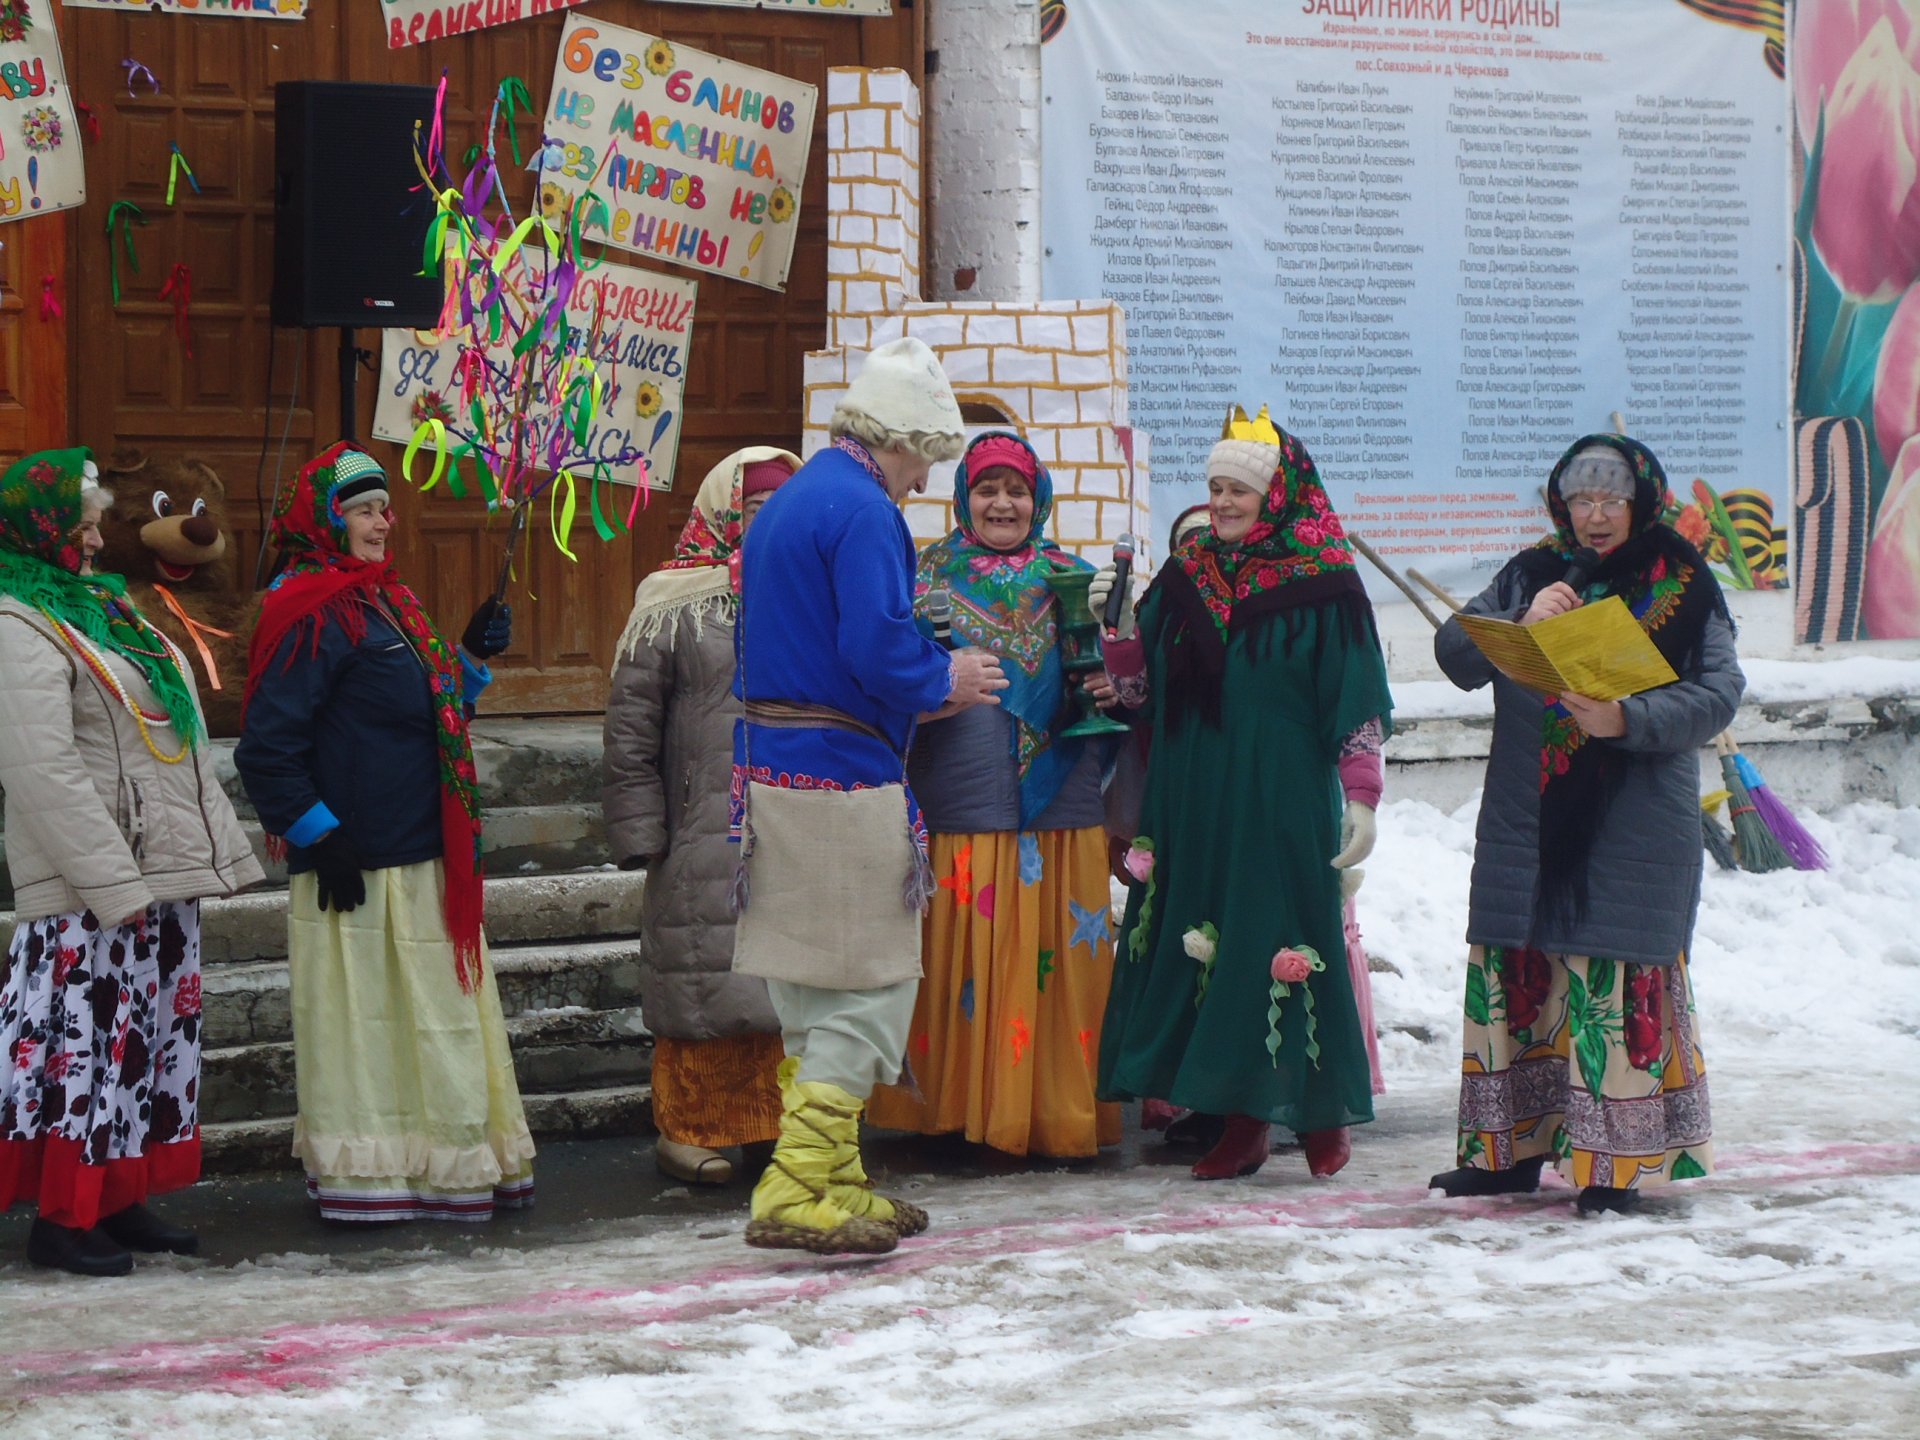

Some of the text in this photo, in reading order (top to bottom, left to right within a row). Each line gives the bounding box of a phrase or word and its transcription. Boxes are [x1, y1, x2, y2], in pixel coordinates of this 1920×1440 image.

[1284, 35, 1349, 49] восстановили
[1133, 72, 1223, 88] Анатолий Иванович
[1337, 82, 1360, 95] Иван
[1184, 94, 1213, 106] Ильич
[1317, 98, 1414, 114] Григорий Васильевич
[1141, 108, 1218, 124] Иван Степанович
[1326, 116, 1405, 133] Михаил Петрович
[1137, 126, 1177, 140] Николай
[1357, 135, 1409, 149] Васильевич
[546, 138, 597, 181] ез
[1141, 144, 1224, 162] Алексей Петрович
[1322, 151, 1415, 167] Василий Алексеевич
[1143, 163, 1226, 179] Иван Дмитриевич
[1317, 169, 1356, 182] Василий
[1459, 173, 1486, 186] Попов
[1359, 188, 1412, 202] Артемьевич
[1468, 190, 1495, 204] Попов
[1168, 200, 1218, 215] Андреевич
[1331, 205, 1399, 218] Иван Иванович
[1466, 208, 1493, 221] Попов
[1140, 218, 1228, 232] Николай Иванович
[1321, 222, 1352, 235] Степан
[1464, 225, 1492, 238] Попов
[1133, 235, 1232, 250] Артемий Михайлович
[1321, 240, 1372, 253] Константин
[1468, 242, 1495, 256] Попов
[1145, 254, 1216, 269] Юрий Петрович
[1319, 257, 1413, 272] Дмитрий Игнатьевич
[1459, 260, 1487, 273] Попов
[1103, 270, 1220, 286] Казаков Иван Андреевич
[1318, 276, 1415, 291] Александр Андреевич
[1465, 277, 1491, 290] Попов
[1143, 289, 1223, 304] Ефим Данилович
[1357, 294, 1407, 306] Моисеевич
[1133, 307, 1233, 323] Григорий Васильевич
[1326, 310, 1393, 323] Иван Иванович
[1465, 312, 1491, 325] Попов
[1142, 325, 1172, 339] Павел
[1322, 328, 1410, 342] Николай Борисович
[1461, 328, 1487, 341] Попов
[1141, 344, 1236, 359] Анатолий Руфанович
[1320, 346, 1413, 360] Георгий Максимович
[1464, 346, 1522, 358] Попов Степан
[1136, 362, 1241, 376] Константин Руфанович
[1317, 363, 1421, 378] Александр Дмитриевич
[1460, 363, 1527, 375] Попов Василий
[1141, 380, 1237, 393] Максим Николаевич
[1335, 381, 1407, 396] Иван Андреевич
[1456, 380, 1531, 394] Попов Александр
[1141, 398, 1181, 411] Василий
[1498, 397, 1573, 413] Михаил Петрович
[1140, 416, 1179, 430] Андриян
[1323, 433, 1361, 446] Василий
[1491, 432, 1527, 445] Алексей
[1492, 449, 1536, 463] Александр
[1322, 469, 1414, 482] Александр Иванович
[1485, 466, 1521, 478] Николай
[1440, 509, 1505, 520] независимость
[1451, 526, 1510, 538] вернувшимся
[1378, 544, 1436, 554] возможность
[1440, 543, 1467, 554] мирно
[1470, 541, 1508, 554] работать
